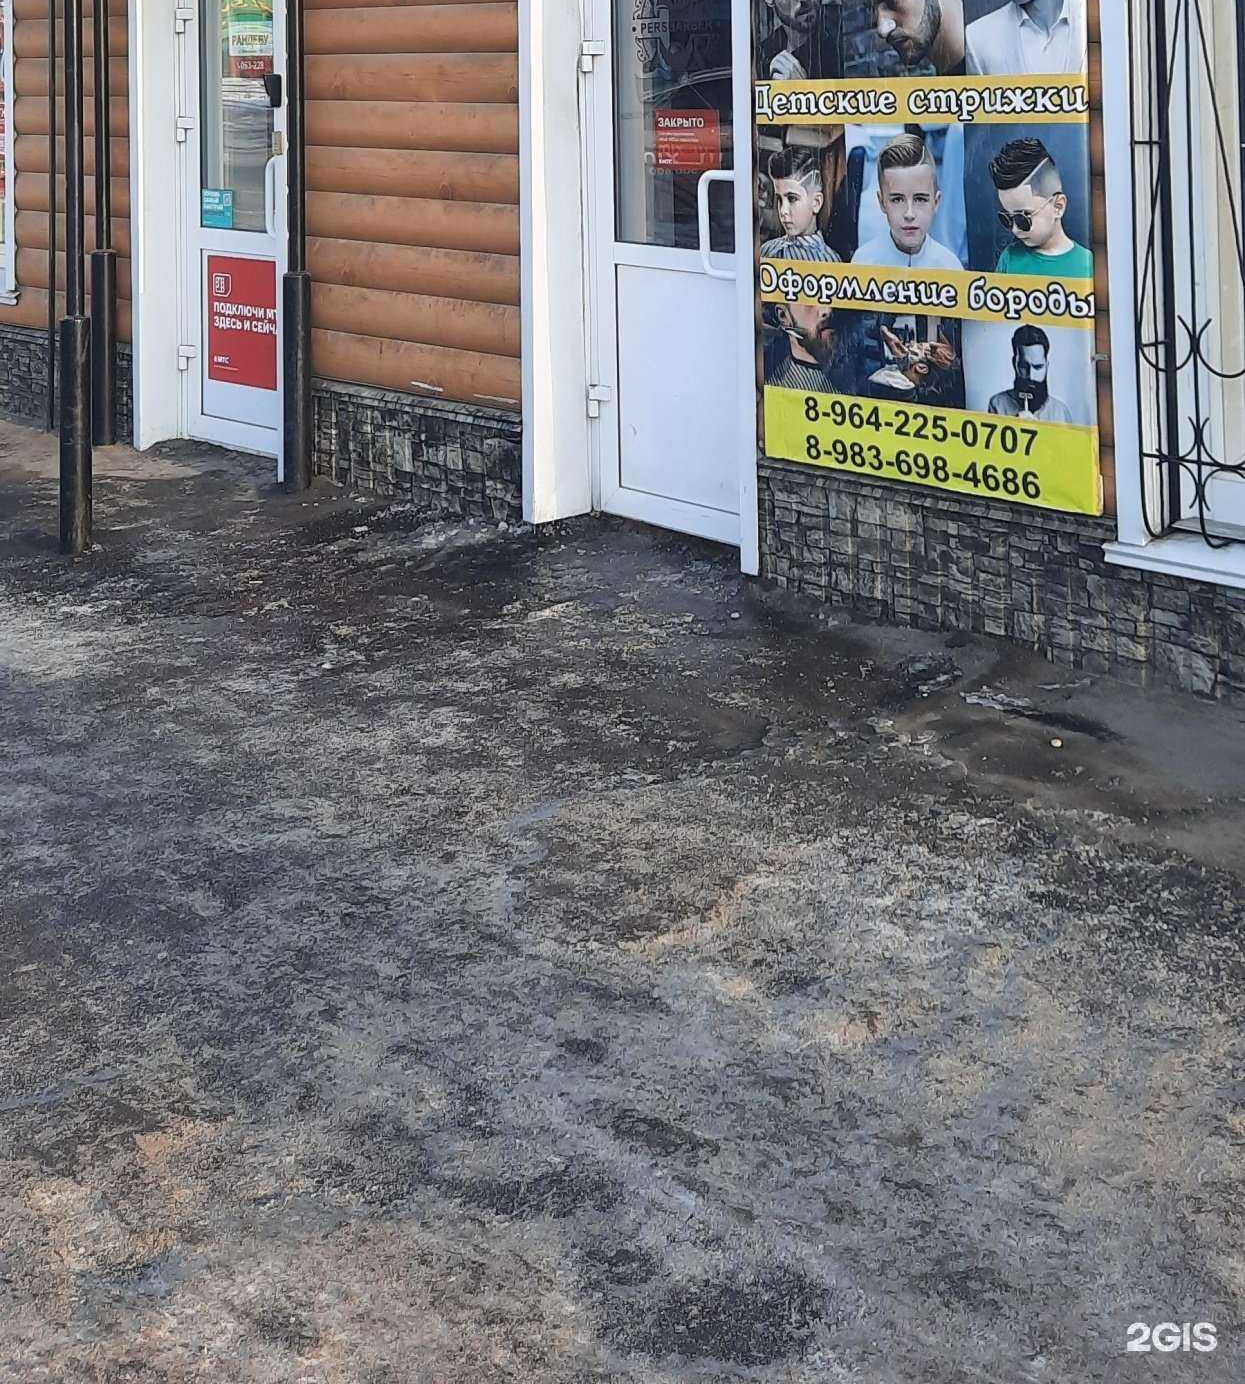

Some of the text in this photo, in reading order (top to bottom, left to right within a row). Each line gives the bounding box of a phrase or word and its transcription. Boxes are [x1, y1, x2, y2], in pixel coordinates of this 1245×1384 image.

[755, 84, 1088, 120] Детские стрижки
[657, 117, 704, 128] ЗАКРЫТО
[759, 263, 1095, 318] Оформление бороды
[213, 301, 265, 319] ПОДКЛЮЧИ
[213, 315, 242, 331] ЗДЕСЬ
[243, 319, 251, 331] И
[804, 396, 1038, 457] 8-964-225-0707
[805, 434, 1041, 499] 8-983-698-4686
